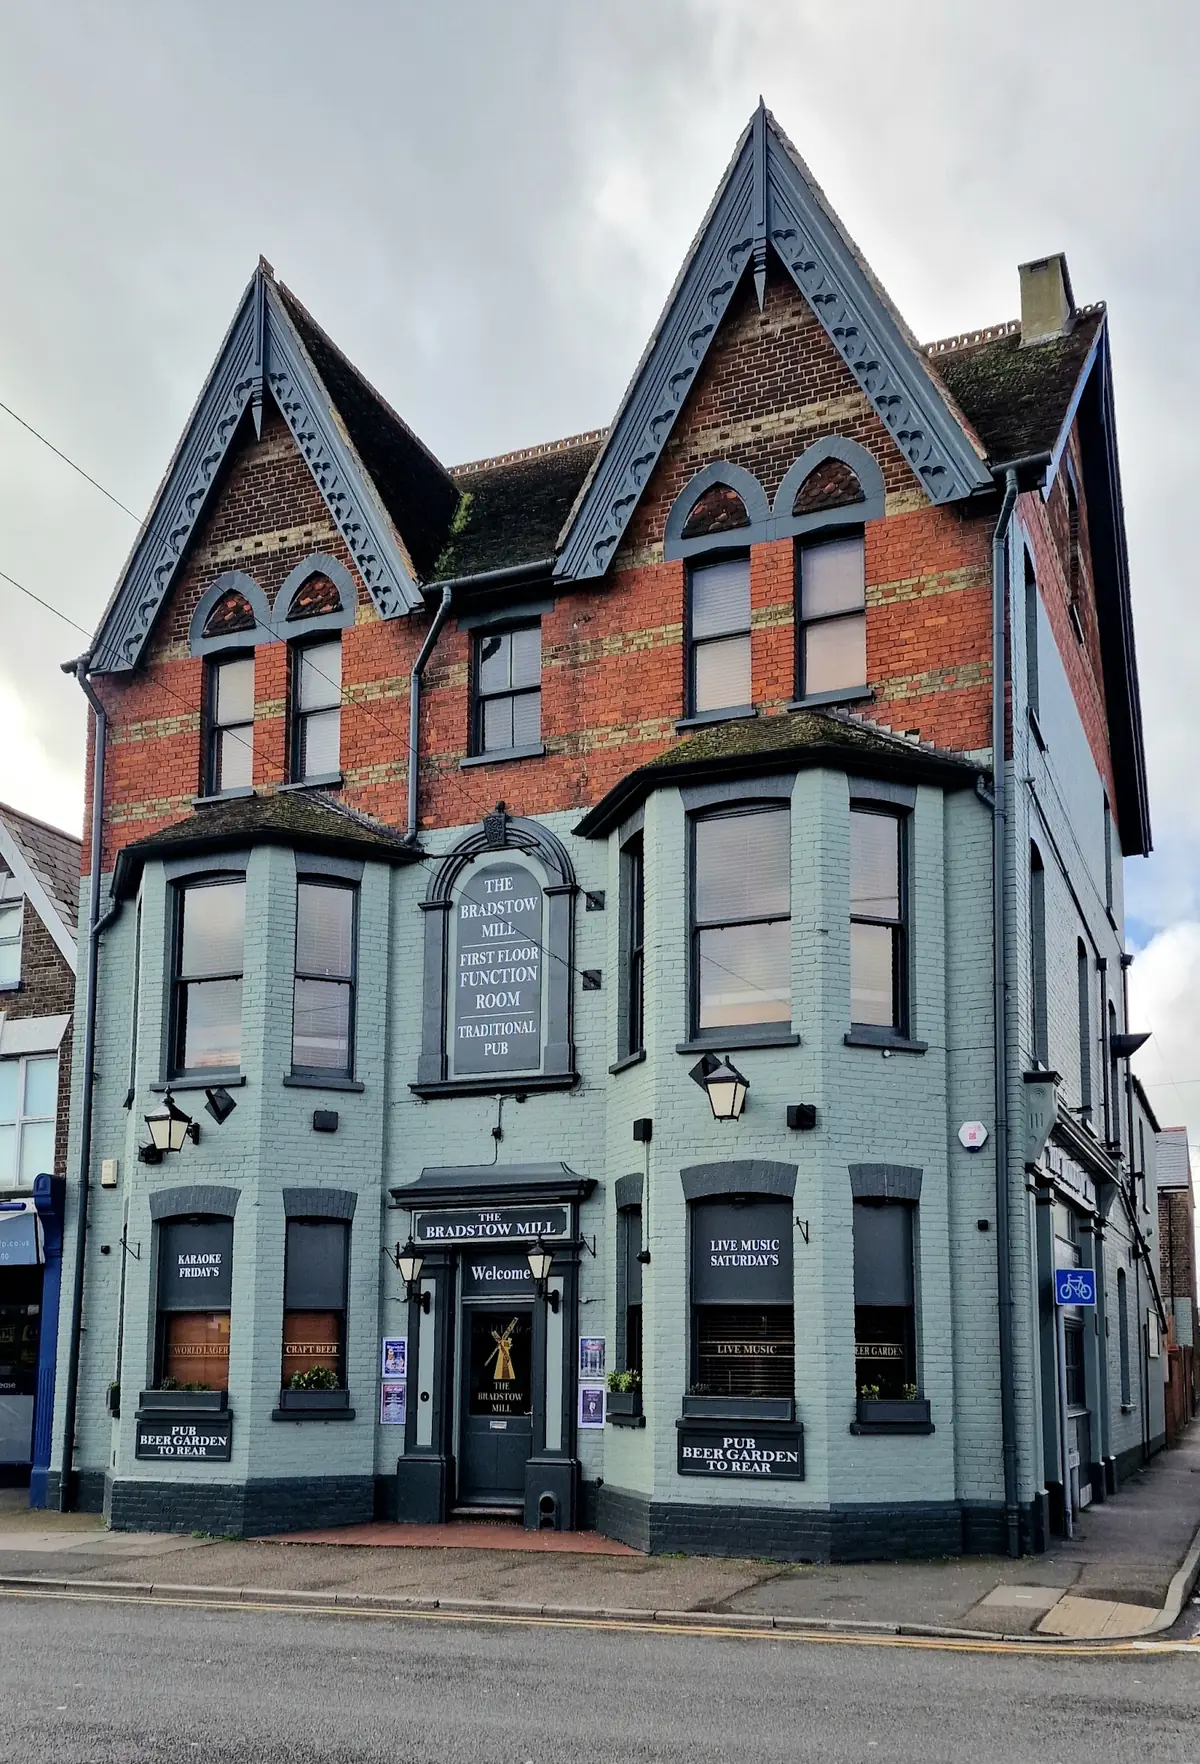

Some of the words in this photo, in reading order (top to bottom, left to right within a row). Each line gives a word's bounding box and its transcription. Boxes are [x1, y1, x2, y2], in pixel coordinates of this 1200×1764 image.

[484, 876, 514, 893] THE
[460, 896, 539, 919] BRADSTOW
[481, 921, 516, 938] MILL
[460, 951, 495, 967] FIRST
[497, 946, 539, 963] FLOOR
[460, 965, 538, 988] FUNCTION
[475, 991, 521, 1009] ROOM
[457, 1019, 536, 1039] TRADITIONAL
[483, 1042, 509, 1056] PUB
[478, 1212, 502, 1222] THE
[425, 1223, 513, 1238] BRADSTOW
[516, 1221, 556, 1235] MILL
[710, 1239, 738, 1251] LIVE
[741, 1239, 780, 1251] MUSIC
[177, 1253, 222, 1265] KARAOKE
[710, 1254, 779, 1267] SATURDAY'S
[178, 1266, 220, 1278] FRIDAY'S
[471, 1265, 531, 1281] Welcome
[174, 1345, 202, 1355] WORLD
[203, 1345, 228, 1354] LAGER
[286, 1345, 315, 1353] CRAFT
[315, 1345, 338, 1353] BEER
[717, 1345, 741, 1354] LIVE
[743, 1345, 777, 1354] MUSIC
[855, 1346, 870, 1355] EER
[871, 1346, 904, 1356] GARDEN
[493, 1381, 510, 1390] THE
[477, 1392, 523, 1401] BRADSTOW
[491, 1404, 512, 1412] MILL
[171, 1426, 197, 1436] PUB
[140, 1435, 173, 1446] BEER
[173, 1435, 228, 1446] GARDEN
[722, 1437, 756, 1449] PUB
[158, 1446, 175, 1455] TO
[176, 1446, 207, 1456] REAR
[682, 1446, 726, 1460] BEER
[726, 1449, 799, 1464] GARDEN
[706, 1460, 728, 1471] TO
[731, 1461, 772, 1473] REAR
